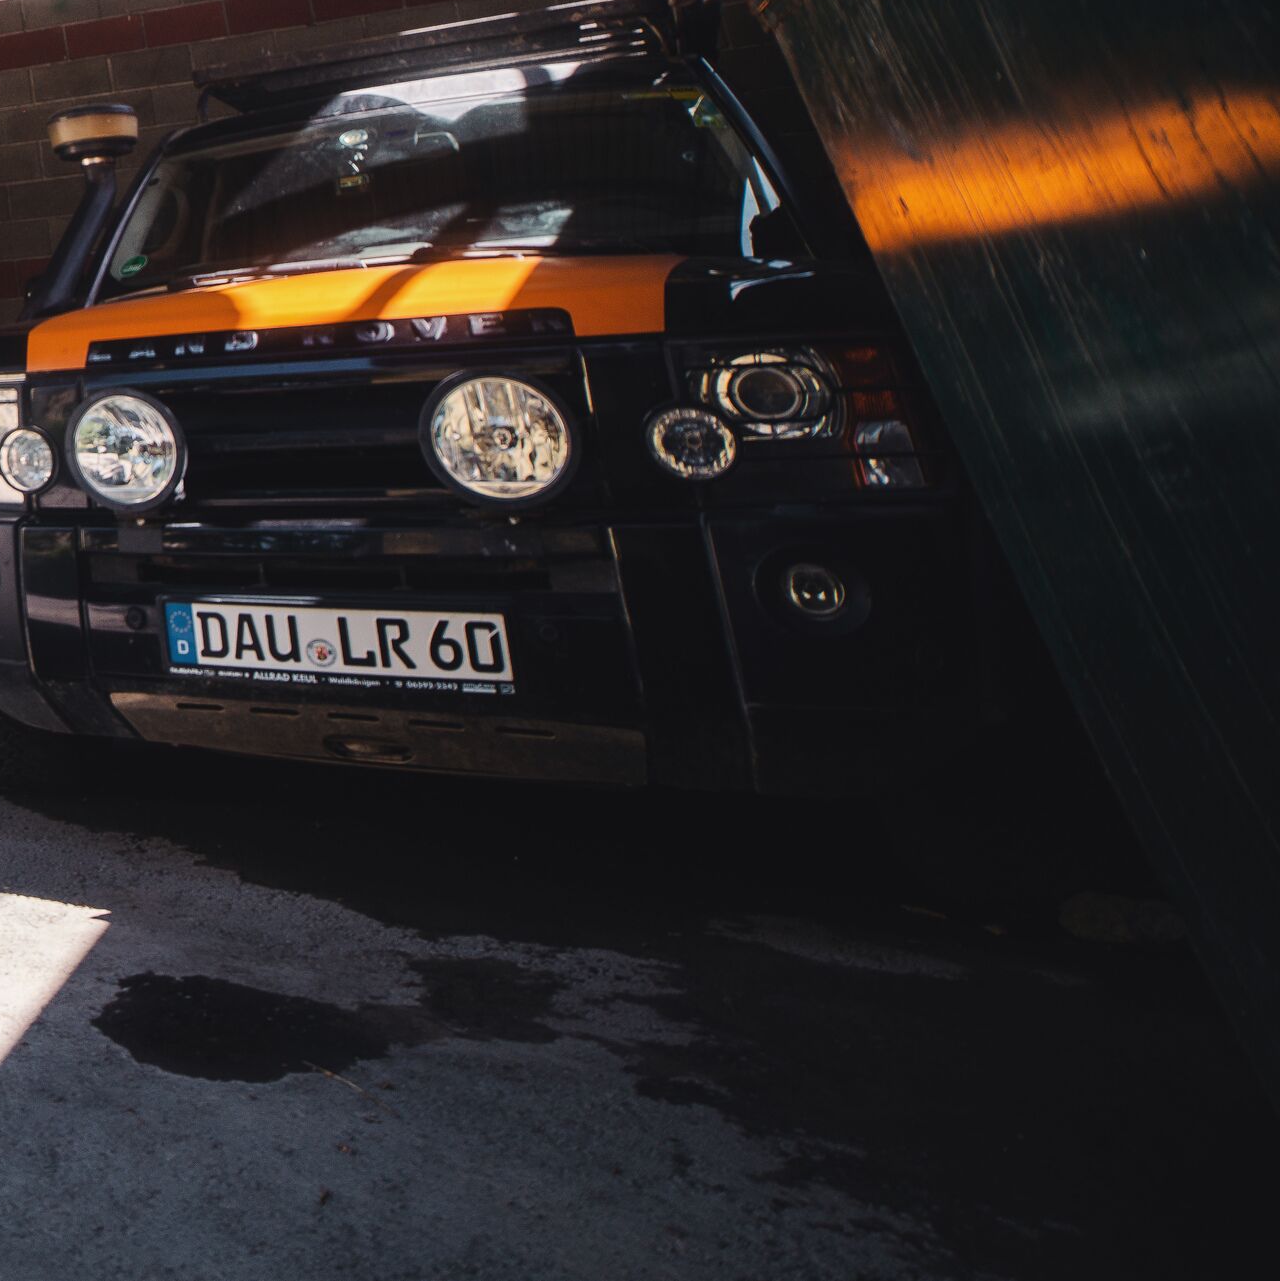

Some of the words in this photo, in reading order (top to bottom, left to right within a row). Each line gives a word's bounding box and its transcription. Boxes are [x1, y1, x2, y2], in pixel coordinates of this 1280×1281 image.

[177, 640, 189, 655] D
[197, 612, 301, 663] DAU
[337, 616, 417, 670] LR
[430, 620, 505, 674] 60
[253, 671, 290, 682] ALLRAD
